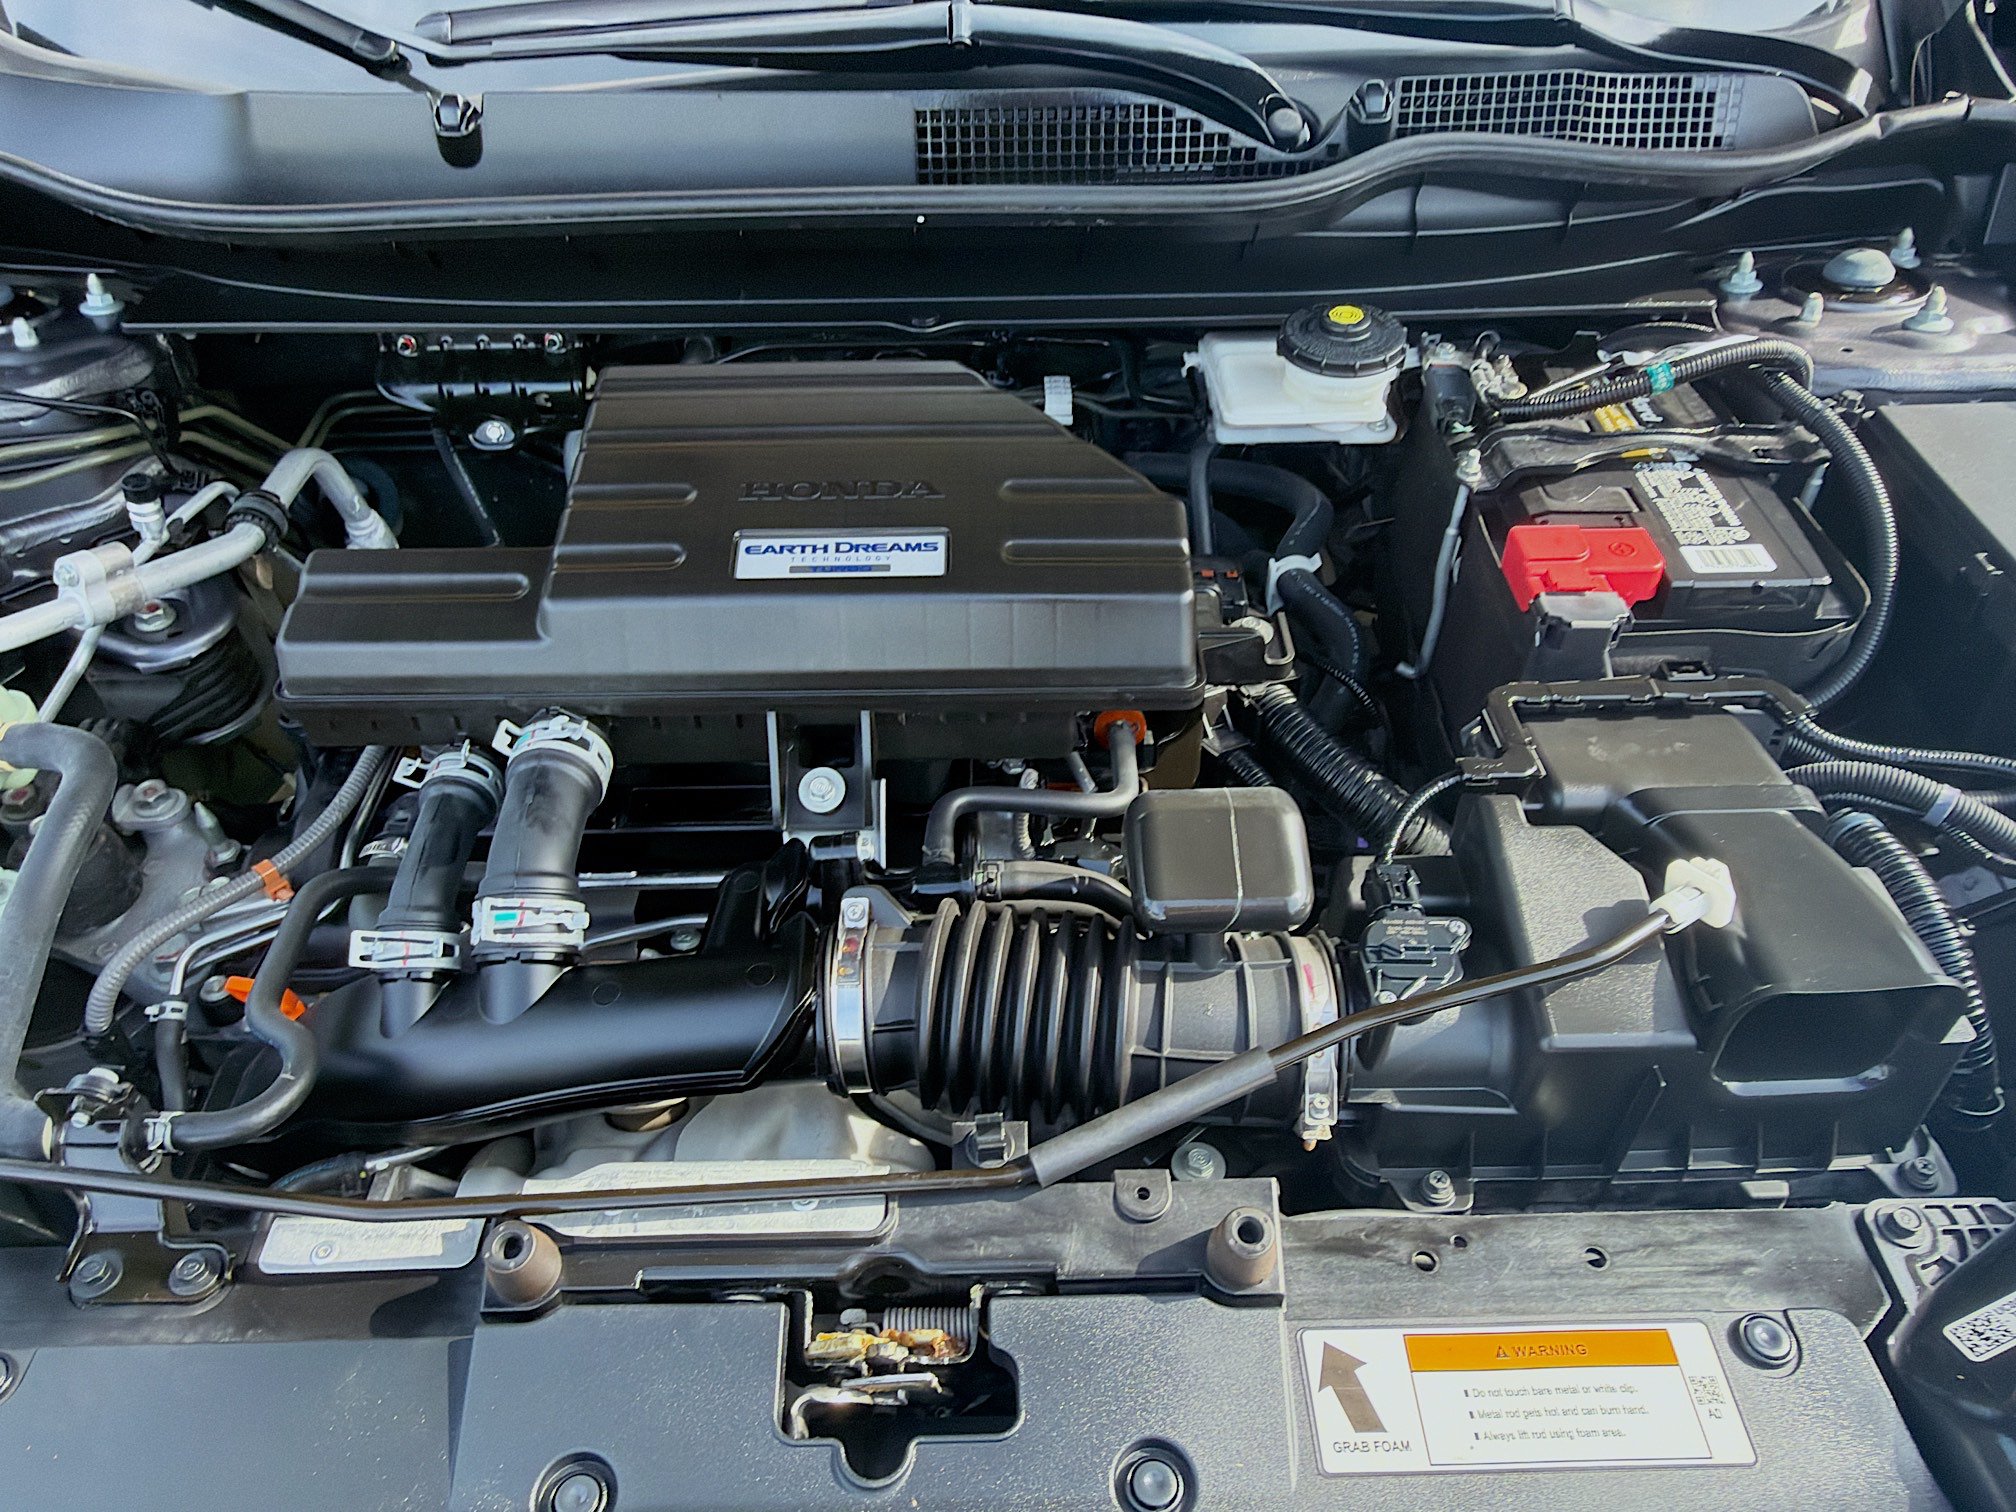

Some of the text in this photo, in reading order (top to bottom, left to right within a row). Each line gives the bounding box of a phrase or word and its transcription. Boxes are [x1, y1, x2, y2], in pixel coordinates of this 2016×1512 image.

[738, 480, 946, 501] HONDA
[745, 542, 939, 555] EARTH DREAMS
[791, 555, 891, 563] TECHNOLOGY
[1512, 1344, 1588, 1358] WARNING
[1472, 1387, 1486, 1398] Do
[1488, 1387, 1503, 1397] not
[1505, 1386, 1530, 1397] touch
[1531, 1385, 1553, 1396] bare
[1555, 1384, 1580, 1395] metal
[1582, 1385, 1591, 1394] or
[1593, 1383, 1617, 1394] white
[1477, 1408, 1503, 1419] Metal
[1505, 1407, 1520, 1418] rod
[1561, 1405, 1579, 1416] and
[1581, 1406, 1599, 1416] can
[1599, 1404, 1621, 1415] burn
[1483, 1430, 1516, 1442] Always
[1531, 1428, 1547, 1439] rod
[1549, 1427, 1574, 1440] using
[1575, 1427, 1600, 1438] foam
[1333, 1439, 1412, 1453] GRAB FOAM
